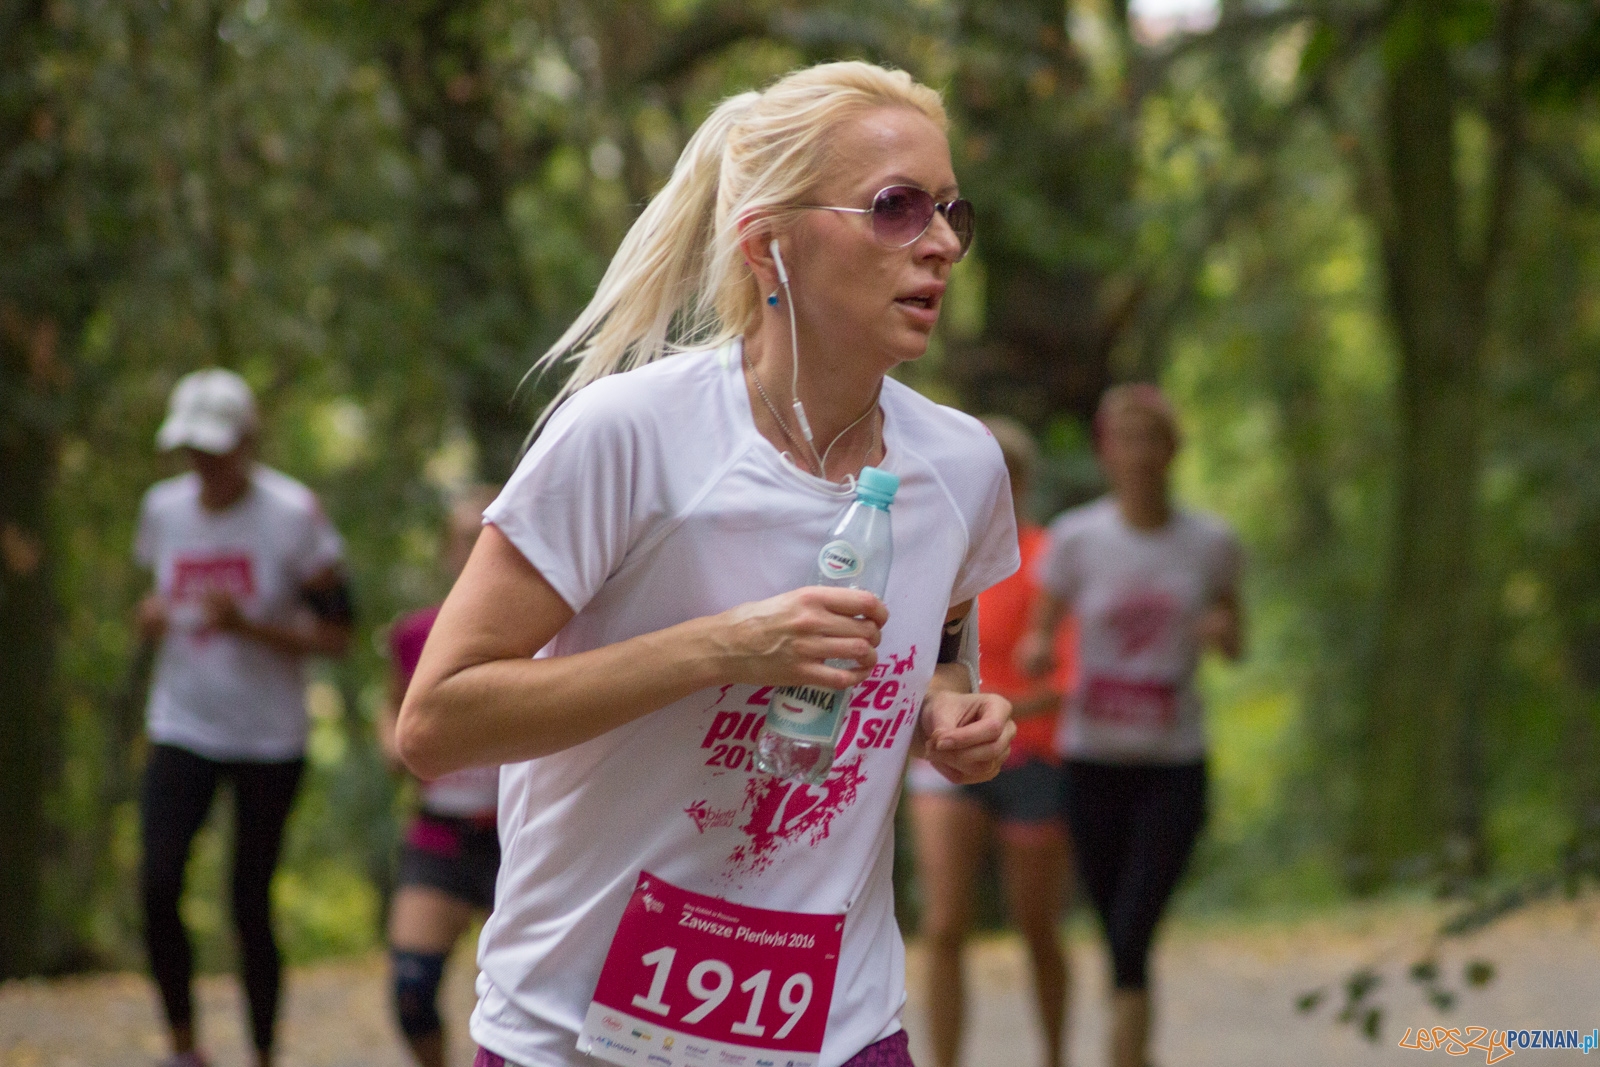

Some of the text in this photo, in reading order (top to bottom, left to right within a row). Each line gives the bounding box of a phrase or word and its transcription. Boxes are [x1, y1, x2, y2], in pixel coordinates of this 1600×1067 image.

[678, 911, 816, 949] Zawsze Pier(w)si 2016
[631, 945, 814, 1040] 1919
